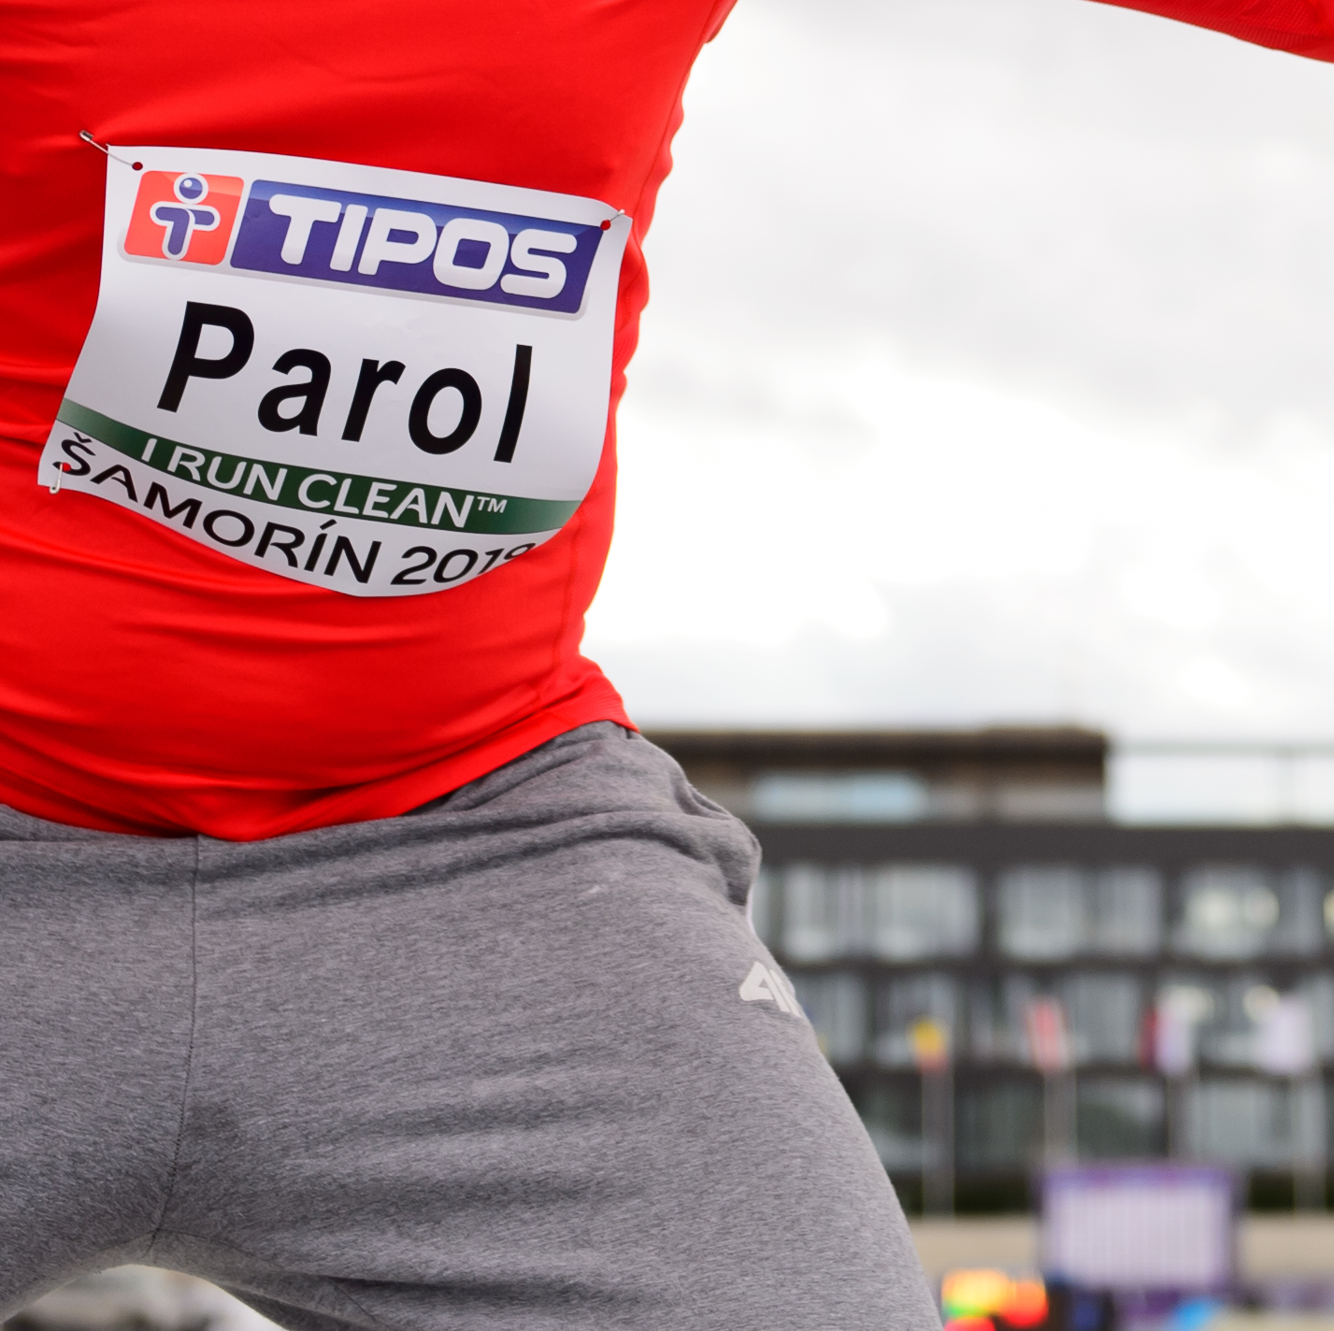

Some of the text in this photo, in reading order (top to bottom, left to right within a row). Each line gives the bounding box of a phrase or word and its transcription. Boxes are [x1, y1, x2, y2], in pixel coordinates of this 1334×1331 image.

[269, 193, 578, 299] TIPOS
[156, 301, 533, 464] Parol
[52, 431, 382, 584] ŠAMORÍN
[141, 437, 158, 463] I
[167, 445, 288, 501] RUN
